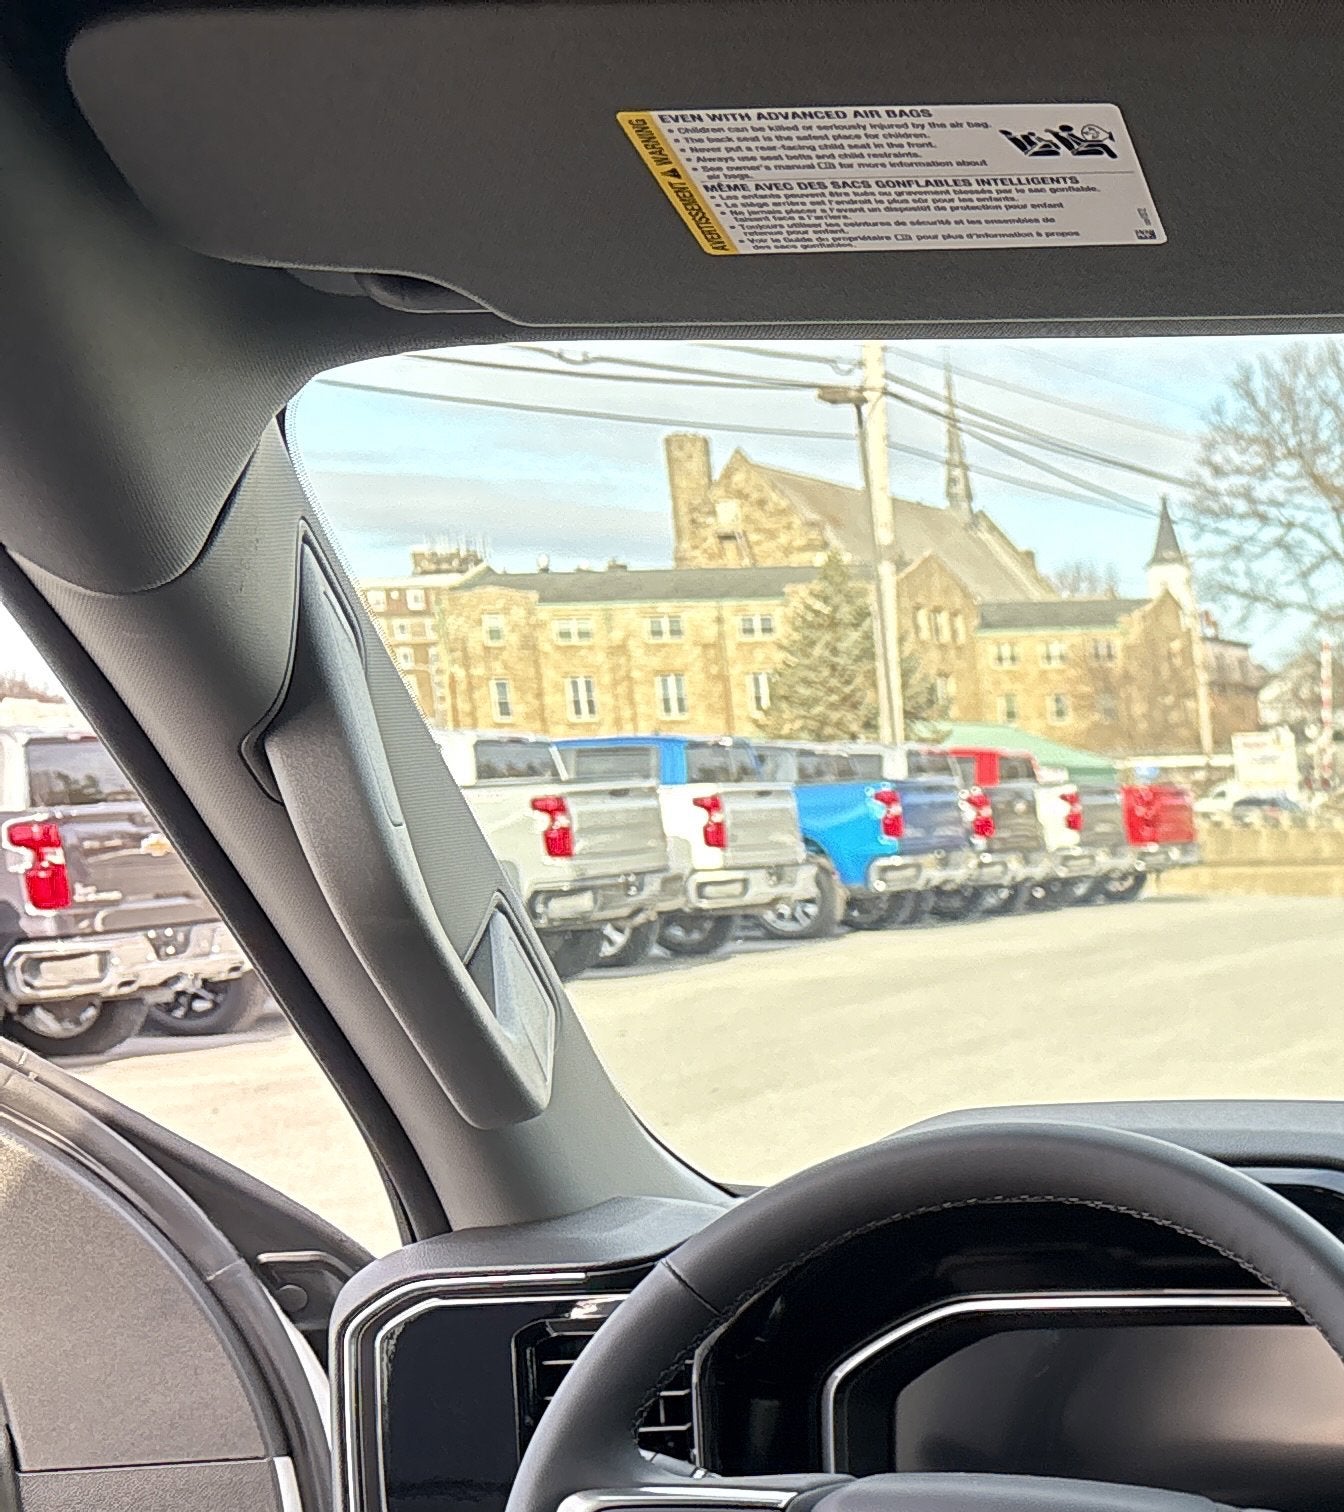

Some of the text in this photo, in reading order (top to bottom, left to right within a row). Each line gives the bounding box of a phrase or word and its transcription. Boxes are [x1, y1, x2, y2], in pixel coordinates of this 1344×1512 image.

[658, 108, 933, 124] EVEN WITH ADVANCED AIR BAGS
[677, 126, 725, 135] Children
[728, 126, 748, 134] can
[751, 125, 765, 133] be
[768, 124, 799, 132] killed
[816, 123, 867, 132] seriously
[869, 122, 909, 131] injured
[912, 122, 926, 131] by
[949, 121, 964, 129] air
[627, 118, 672, 166] WARNING
[684, 136, 704, 144] The
[707, 136, 735, 144] back
[737, 135, 760, 143] seat
[775, 134, 793, 142] the
[796, 134, 830, 142] safest
[832, 133, 862, 141] place
[865, 132, 879, 140] for
[725, 145, 743, 154] put
[818, 143, 845, 151] child
[847, 142, 871, 150] seat
[696, 155, 736, 164] Always
[760, 154, 783, 162] seat
[786, 153, 813, 161] belts
[815, 152, 835, 160] and
[773, 163, 815, 171] manual
[889, 160, 954, 168] information
[956, 159, 988, 167] about
[702, 175, 1080, 193] MÊME AVEC DES SACS GONFLABLES INTELLIGENTS
[667, 181, 731, 251] AVERTISSEMENT
